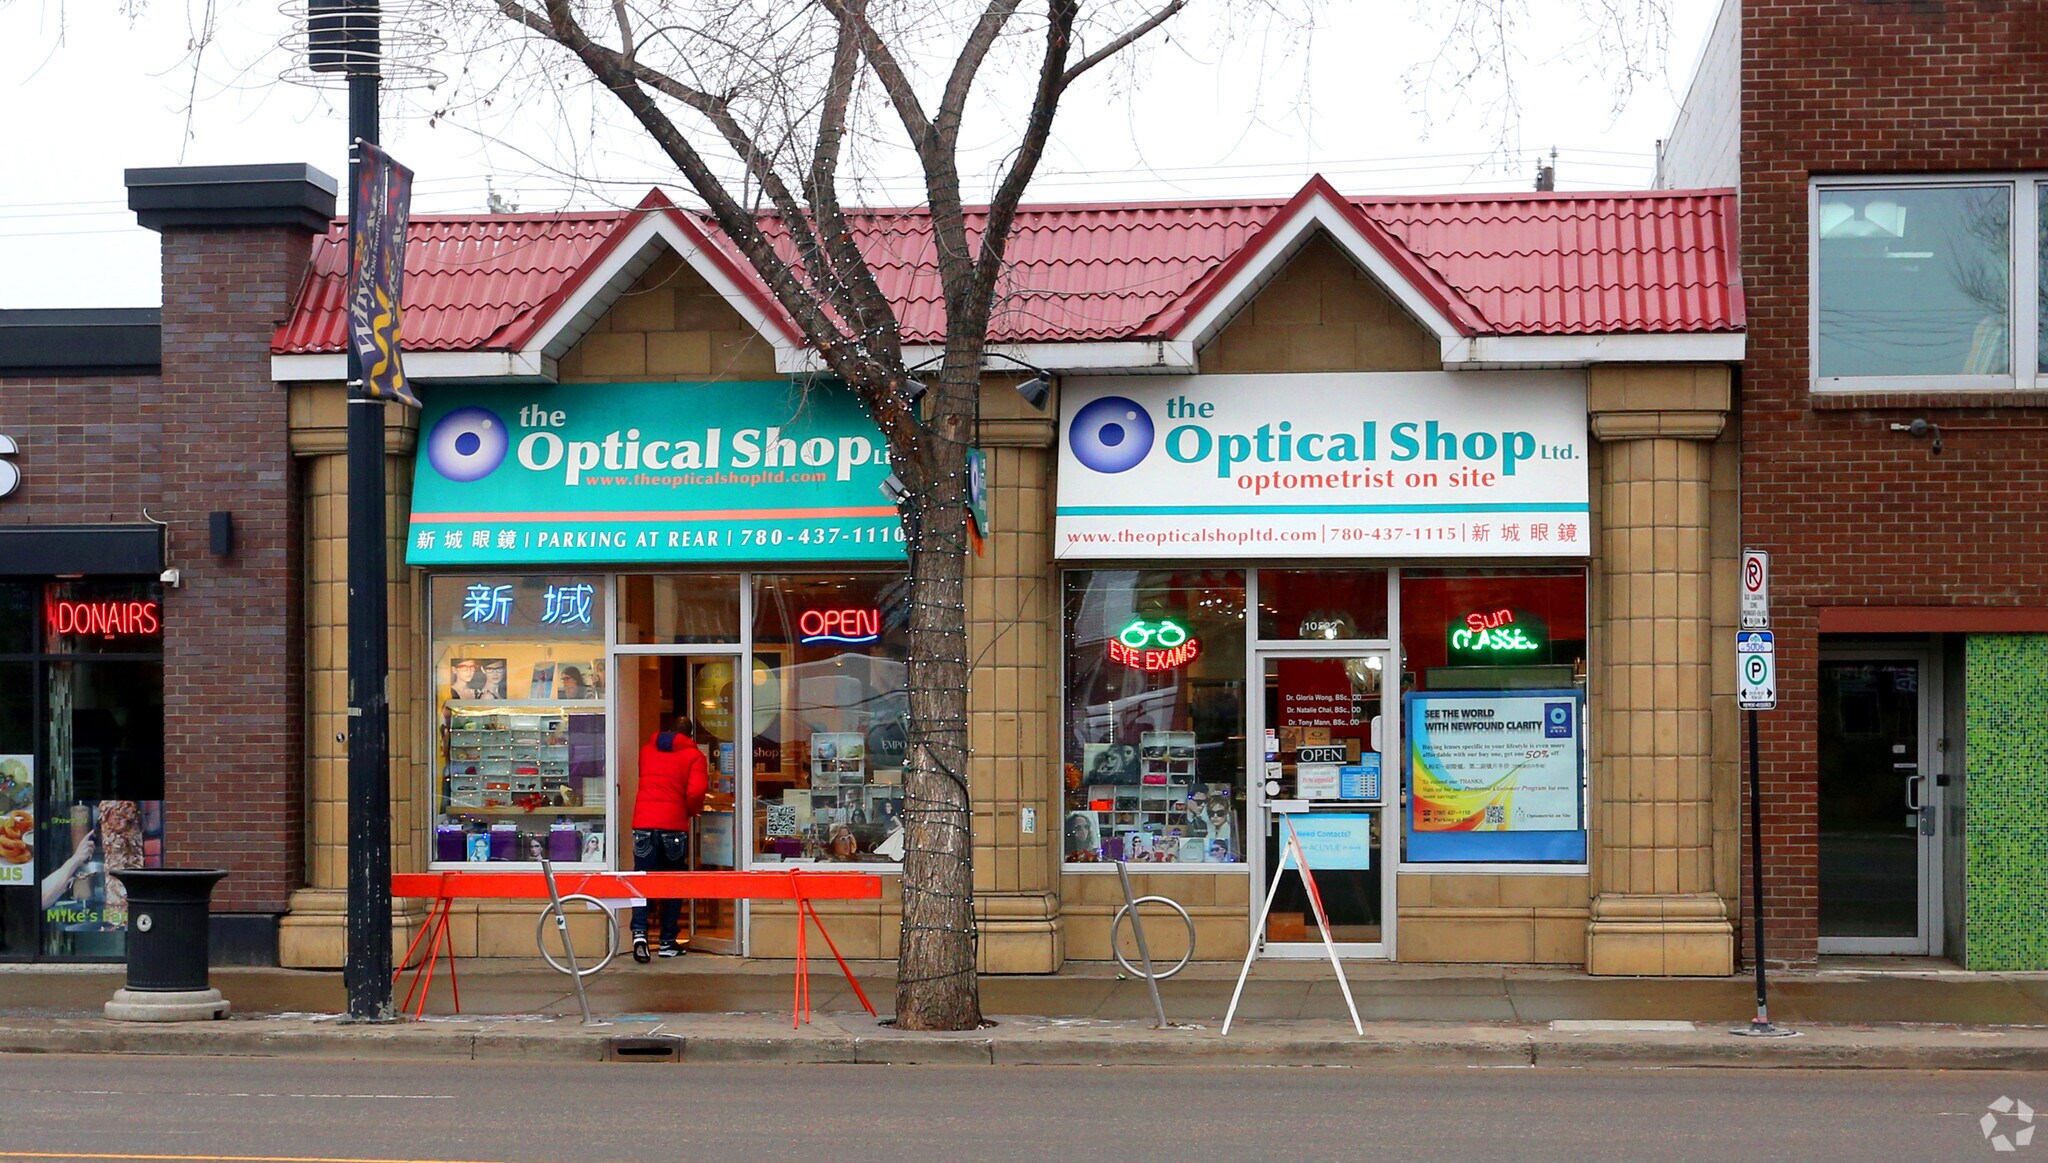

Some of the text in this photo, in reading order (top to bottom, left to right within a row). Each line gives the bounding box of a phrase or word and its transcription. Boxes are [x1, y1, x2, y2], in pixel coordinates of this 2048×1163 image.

[519, 404, 566, 427] the
[1166, 396, 1214, 418] the
[517, 427, 721, 486] Optical
[731, 426, 872, 481] Shop
[1166, 420, 1579, 478] Optical Shop Ltd.
[585, 471, 827, 489] www.theopticalshopltd.com
[1238, 466, 1496, 496] optometrist on site
[416, 530, 518, 550] 新城眼鏡
[538, 526, 905, 548] PARKING AT REAR 780-437-1110
[1067, 527, 1456, 546] www.theopticalshopltd.com 780-437-1115
[1471, 523, 1578, 543] 新城眼鏡
[462, 583, 595, 626] 新城
[59, 602, 157, 634] DONAIRS
[800, 609, 878, 636] OPEN
[1466, 609, 1513, 634] Sun
[1110, 638, 1196, 670] EYE EXAMS
[1424, 709, 1494, 718] SEE THE WORLD
[1425, 722, 1449, 731] WITH
[1451, 722, 1504, 730] NEWFOUND
[1506, 721, 1542, 730] CLARITY
[754, 748, 779, 759] shop
[1301, 749, 1342, 761] OPEN
[1525, 750, 1549, 758] 50%
